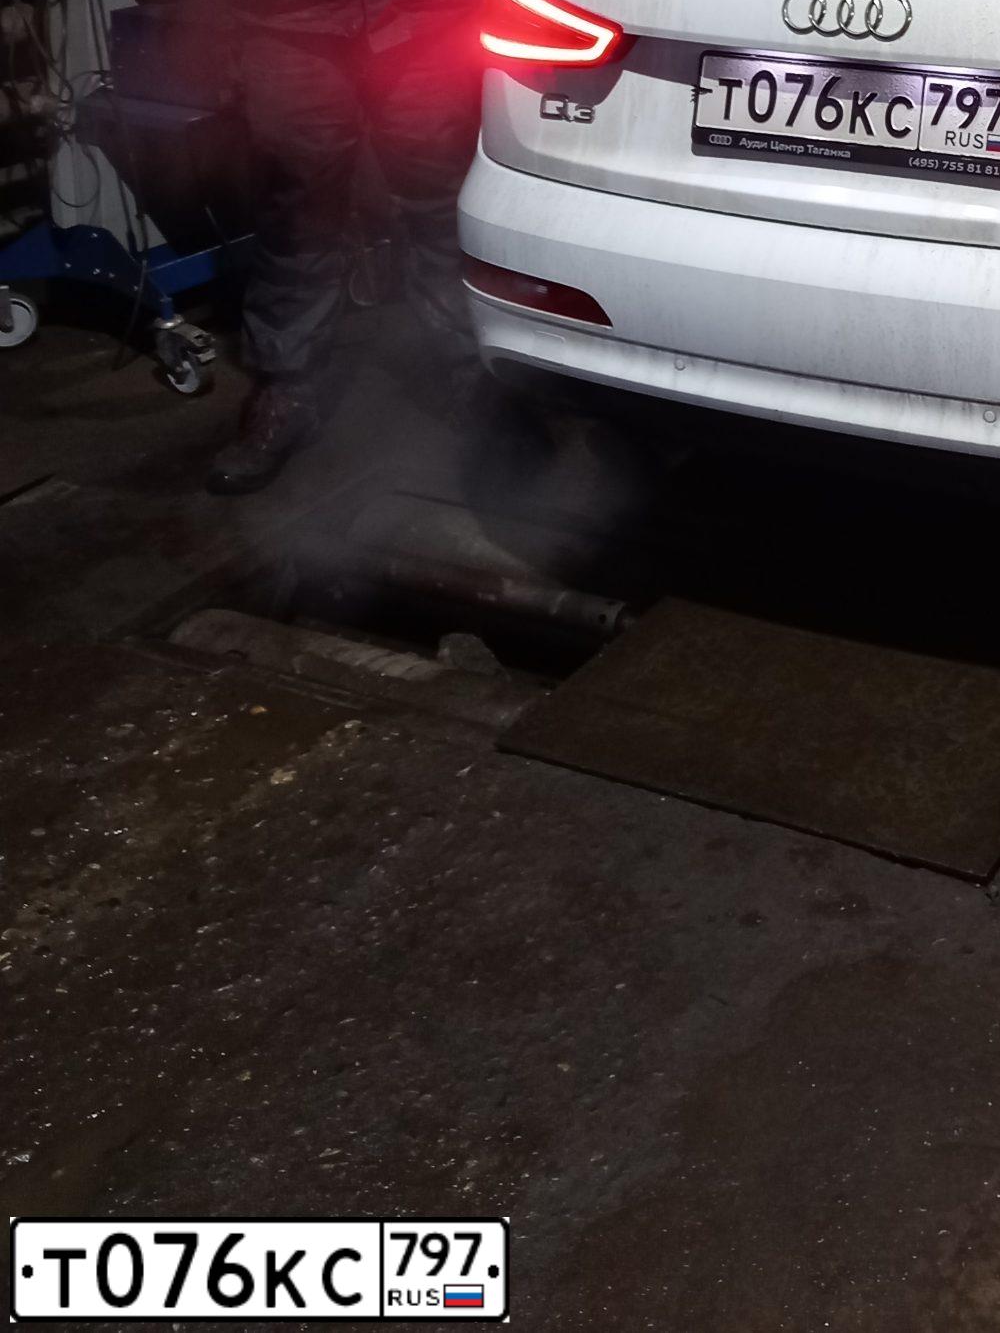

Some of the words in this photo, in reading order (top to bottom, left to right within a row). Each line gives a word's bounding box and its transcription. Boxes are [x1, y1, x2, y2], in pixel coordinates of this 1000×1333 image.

[739, 137, 768, 149] Ауди
[770, 140, 804, 154] Центр
[807, 144, 850, 158] Таганка
[944, 131, 984, 149] RUS
[908, 157, 939, 169] (495)
[942, 160, 964, 171] 755
[967, 163, 981, 174] 81
[985, 165, 1000, 176] 81
